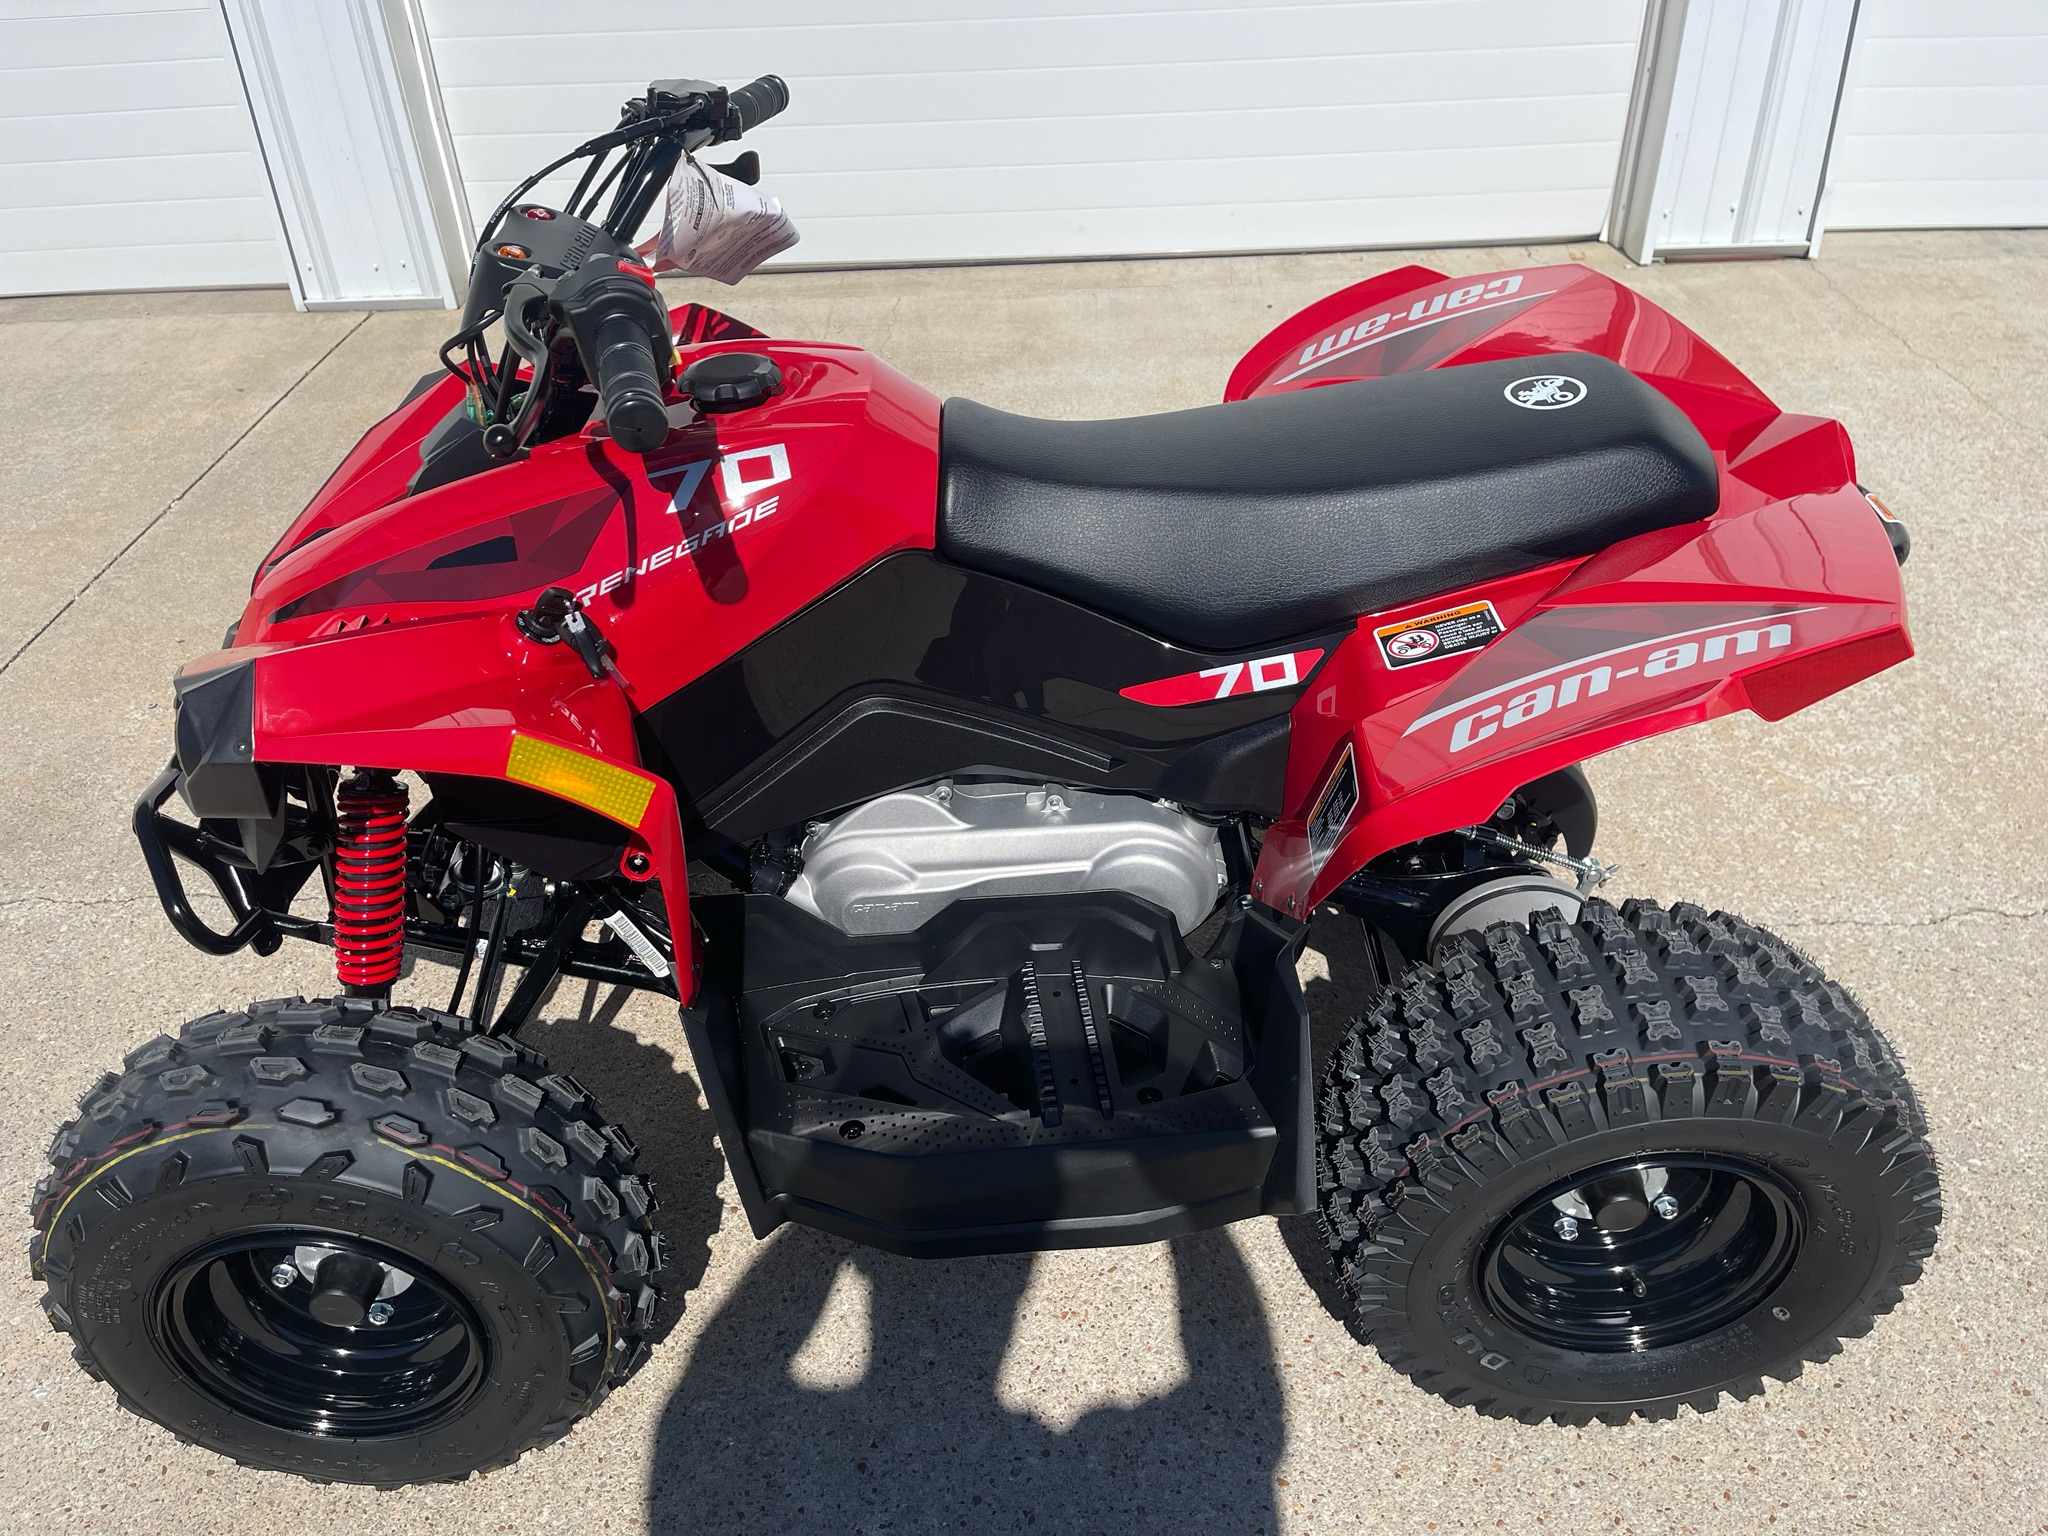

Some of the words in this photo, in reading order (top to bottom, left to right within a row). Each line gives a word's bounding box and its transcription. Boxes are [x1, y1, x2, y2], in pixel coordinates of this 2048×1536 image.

[1298, 275, 1523, 365] can-am
[648, 443, 792, 515] 70
[575, 496, 779, 607] RENEGADE
[1414, 611, 1461, 626] WARNING
[1199, 653, 1299, 699] 70
[1450, 624, 1792, 753] can-am
